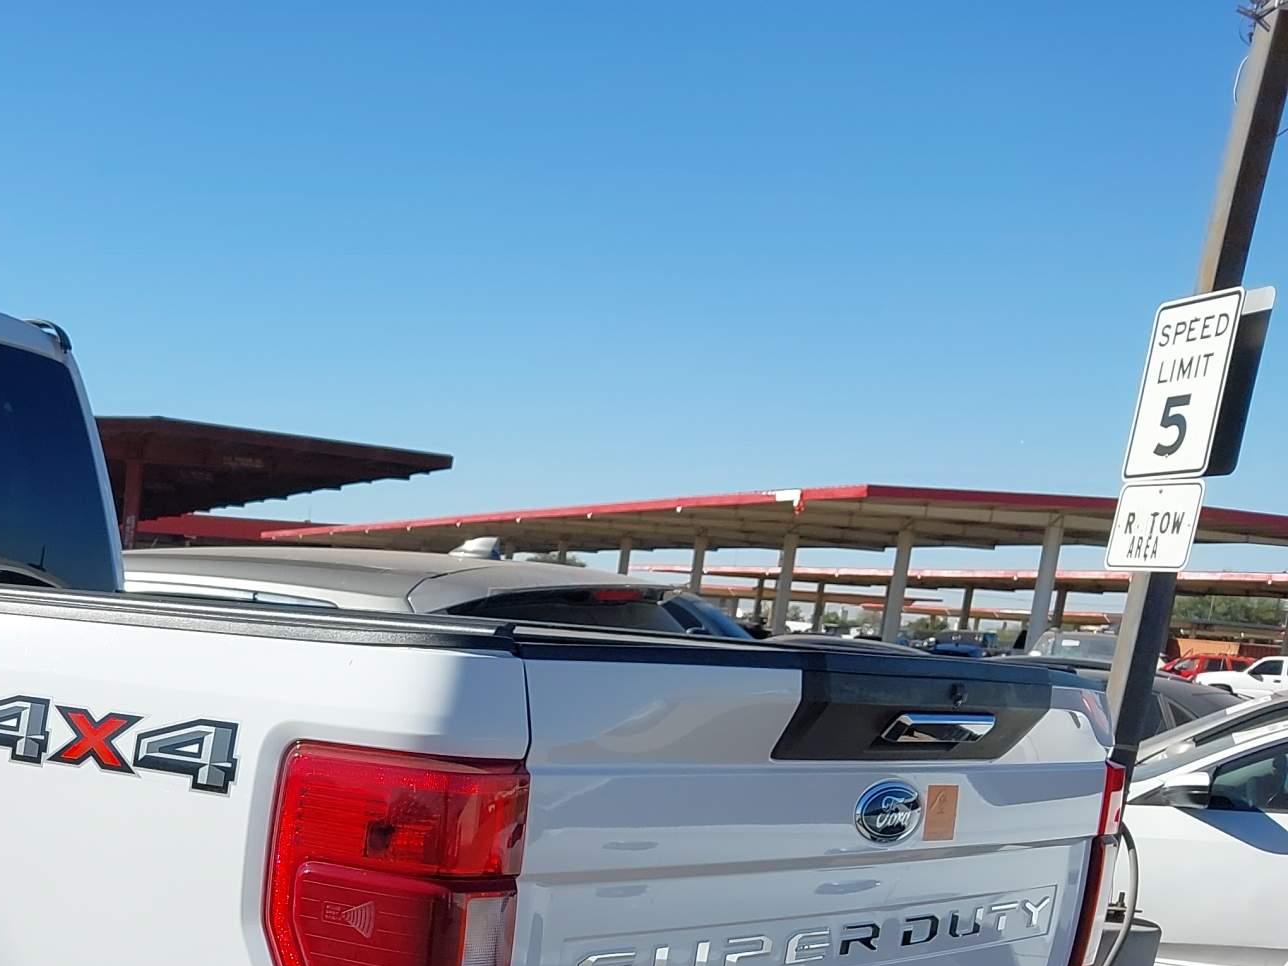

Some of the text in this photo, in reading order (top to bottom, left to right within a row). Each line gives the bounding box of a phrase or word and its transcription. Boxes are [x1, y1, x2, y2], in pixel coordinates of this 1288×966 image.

[1158, 313, 1230, 347] SPEED
[1157, 352, 1215, 384] LIMIT
[1153, 393, 1192, 457] 5
[1149, 511, 1185, 534] TOW
[1126, 535, 1158, 561] AREA
[900, 895, 1052, 947] DUTY
